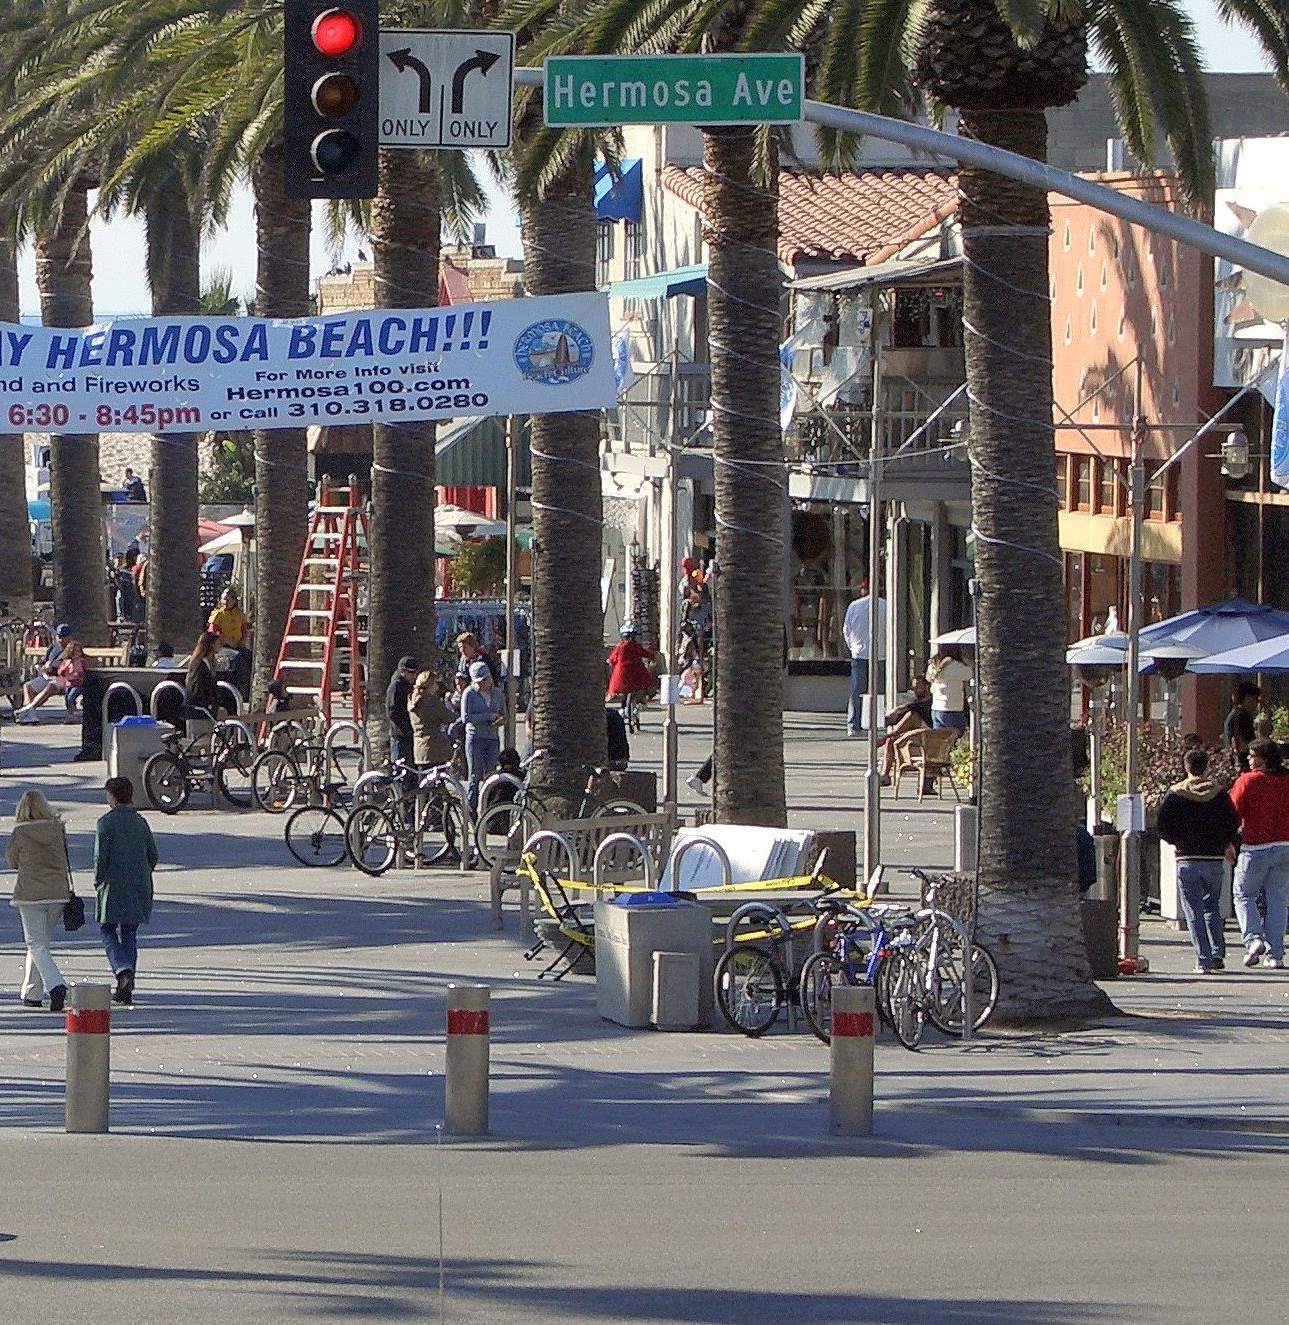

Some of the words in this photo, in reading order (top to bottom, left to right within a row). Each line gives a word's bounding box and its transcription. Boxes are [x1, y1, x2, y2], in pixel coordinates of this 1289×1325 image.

[554, 74, 713, 108] Hermosa
[732, 72, 794, 106] Ave
[382, 119, 430, 136] ONLY
[450, 121, 498, 138] ONLY
[46, 324, 268, 369] HERMOSA
[288, 311, 492, 359] BEACH!!!
[256, 371, 288, 382] For
[296, 369, 347, 380] More
[355, 365, 392, 377] Info
[399, 361, 440, 375] visit
[32, 377, 76, 393] and
[86, 375, 200, 394] Fireworks
[227, 378, 470, 400] Hermosa100.com
[9, 403, 70, 426] 6:30
[96, 404, 201, 430] 8:45pm
[211, 411, 232, 420] or
[239, 407, 278, 419] Call
[288, 393, 489, 417] 310.318.0280
